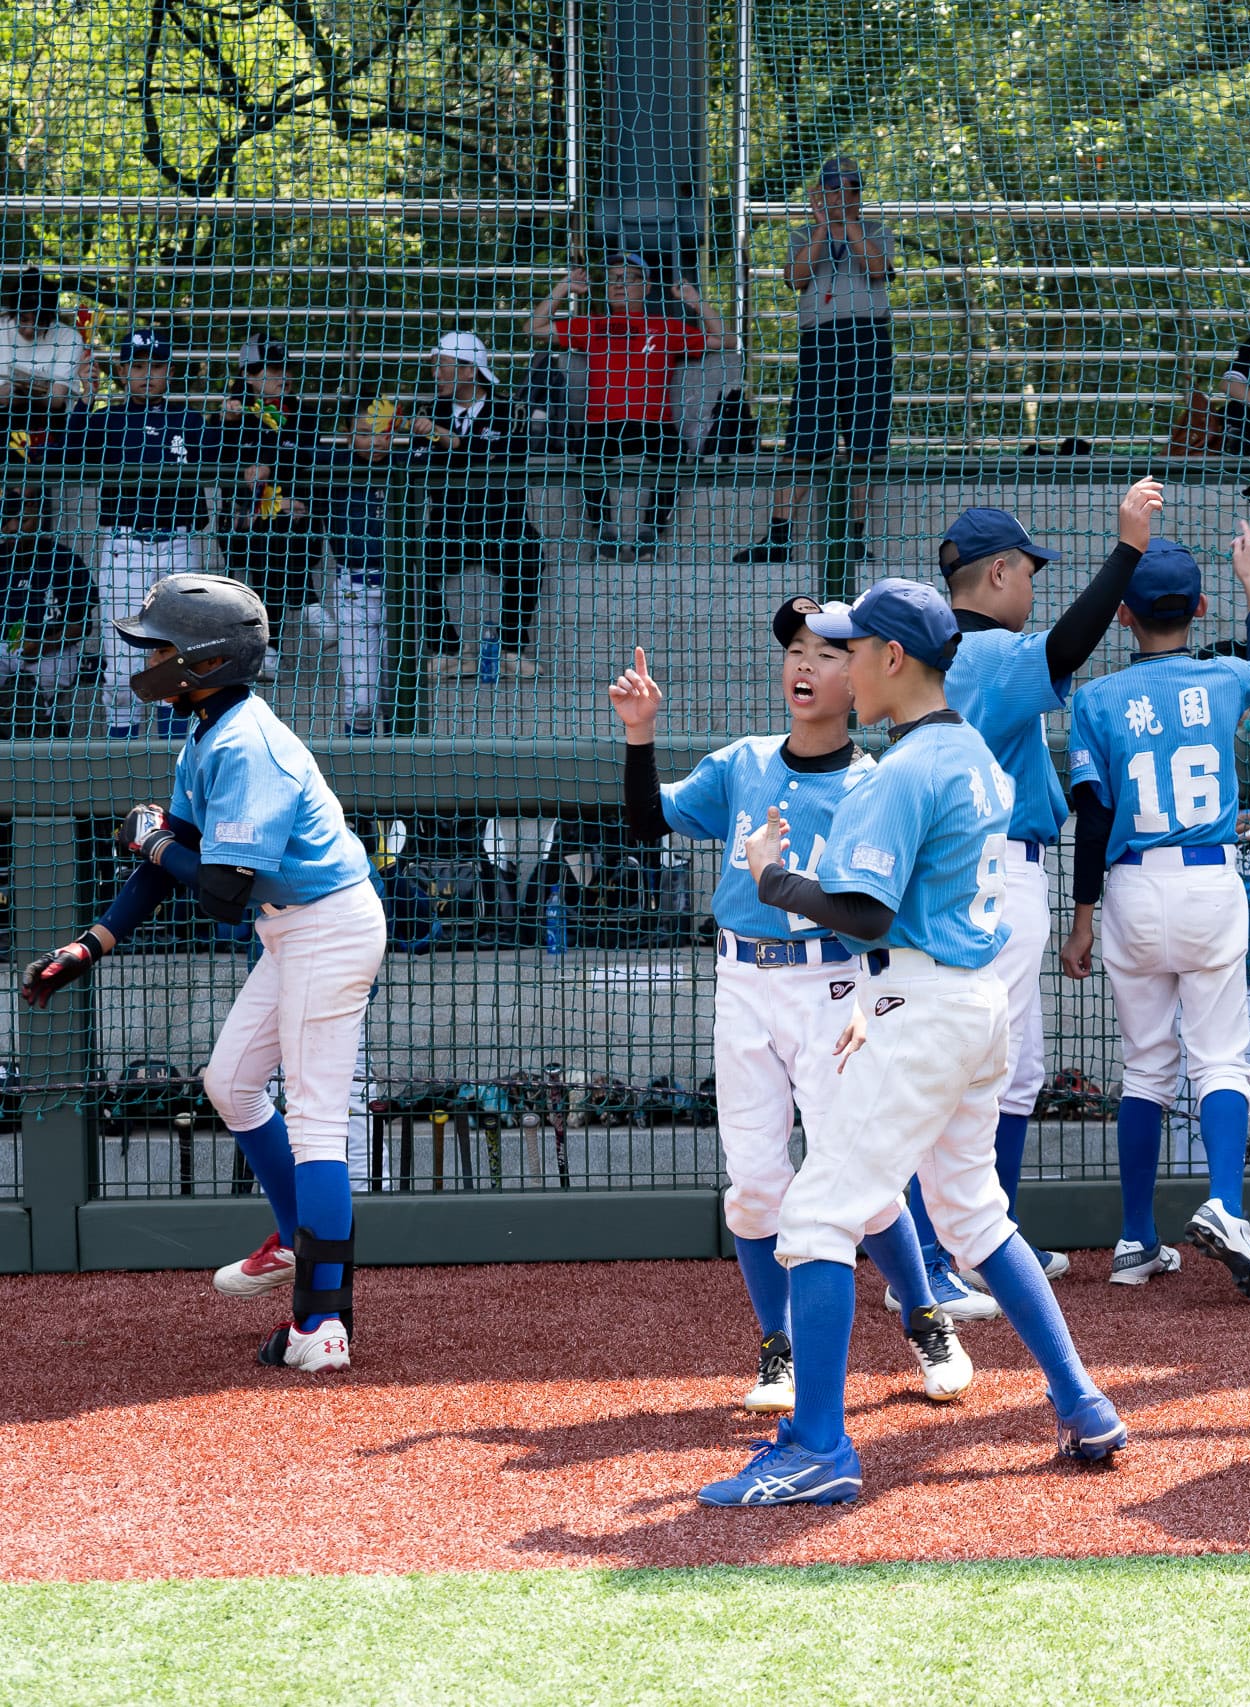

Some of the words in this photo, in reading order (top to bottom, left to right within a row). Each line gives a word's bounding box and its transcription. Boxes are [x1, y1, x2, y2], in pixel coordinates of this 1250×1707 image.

[1124, 686, 1212, 738] 桃園
[1127, 743, 1221, 833] 16
[969, 832, 1008, 936] 8
